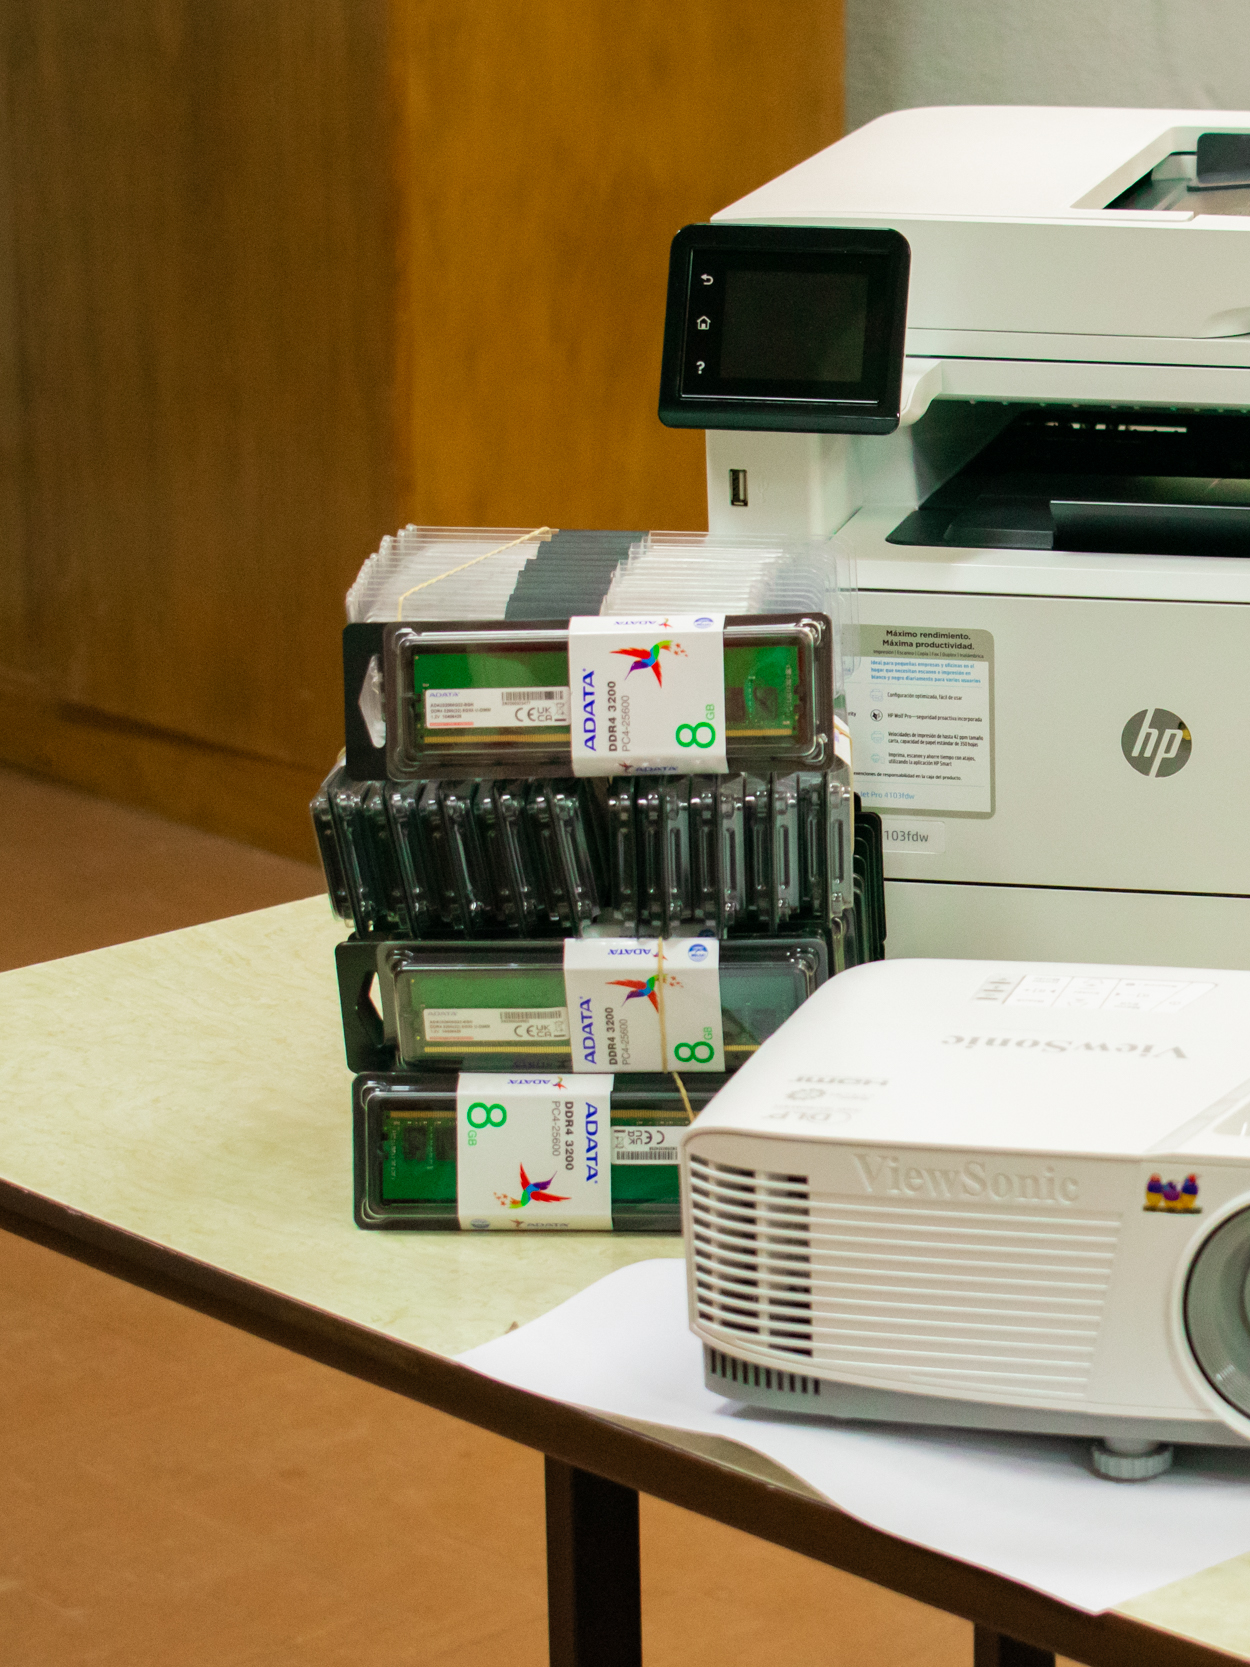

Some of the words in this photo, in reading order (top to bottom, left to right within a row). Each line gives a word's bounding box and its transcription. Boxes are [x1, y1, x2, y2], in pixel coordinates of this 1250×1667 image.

[915, 641, 974, 650] productividad.
[582, 670, 596, 752] ADATA
[607, 681, 616, 712] 3200
[608, 716, 618, 752] DDR4
[621, 695, 631, 752] PC4-25600
[676, 722, 716, 748] 8
[1128, 708, 1186, 778] hp
[884, 830, 929, 842] 103fdw
[580, 998, 597, 1065] ADATA
[605, 1007, 616, 1033] 3200
[607, 1036, 618, 1066] DDR4
[619, 1018, 631, 1066] PC4-25600
[674, 1041, 714, 1064] 8
[941, 1034, 1190, 1061] ViewSonic
[466, 1102, 507, 1129] 8
[552, 1100, 561, 1157] PC4-25600
[564, 1101, 574, 1136] DDR4
[565, 1138, 574, 1171] 3200
[585, 1102, 598, 1182] ADATA
[852, 1153, 1082, 1205] ViewSonic
